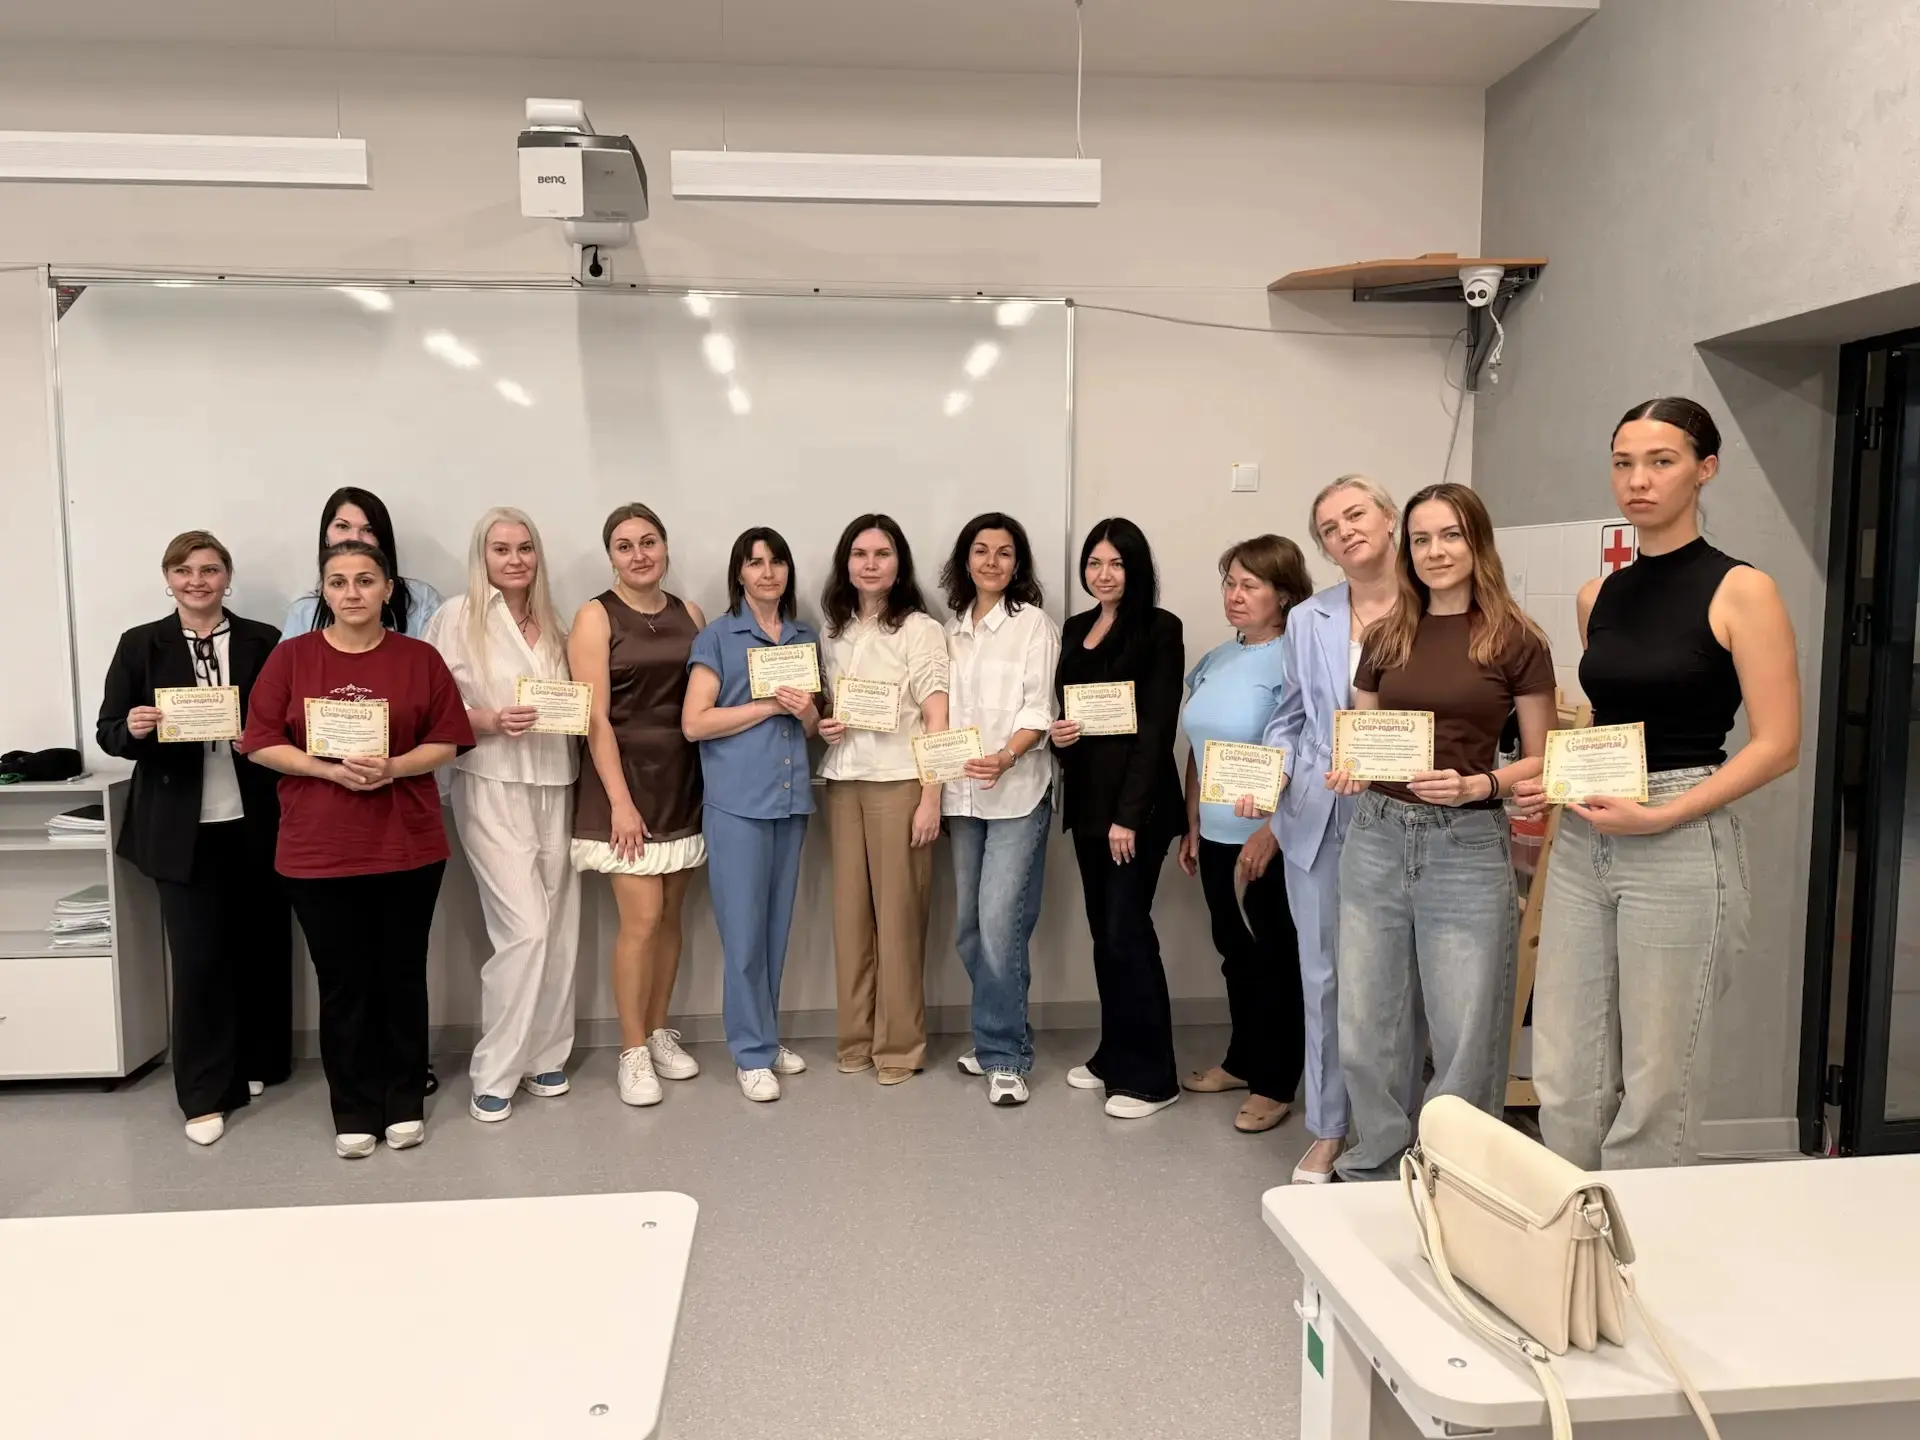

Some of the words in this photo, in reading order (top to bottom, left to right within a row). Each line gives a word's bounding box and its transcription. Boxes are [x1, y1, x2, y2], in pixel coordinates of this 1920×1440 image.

[1358, 724, 1409, 732] СУПЕР-РОДИТЕЛЯ
[1581, 735, 1611, 744] ГРАМОТА
[1571, 742, 1621, 752] СУПЕР-РОДИТЕЛЯ
